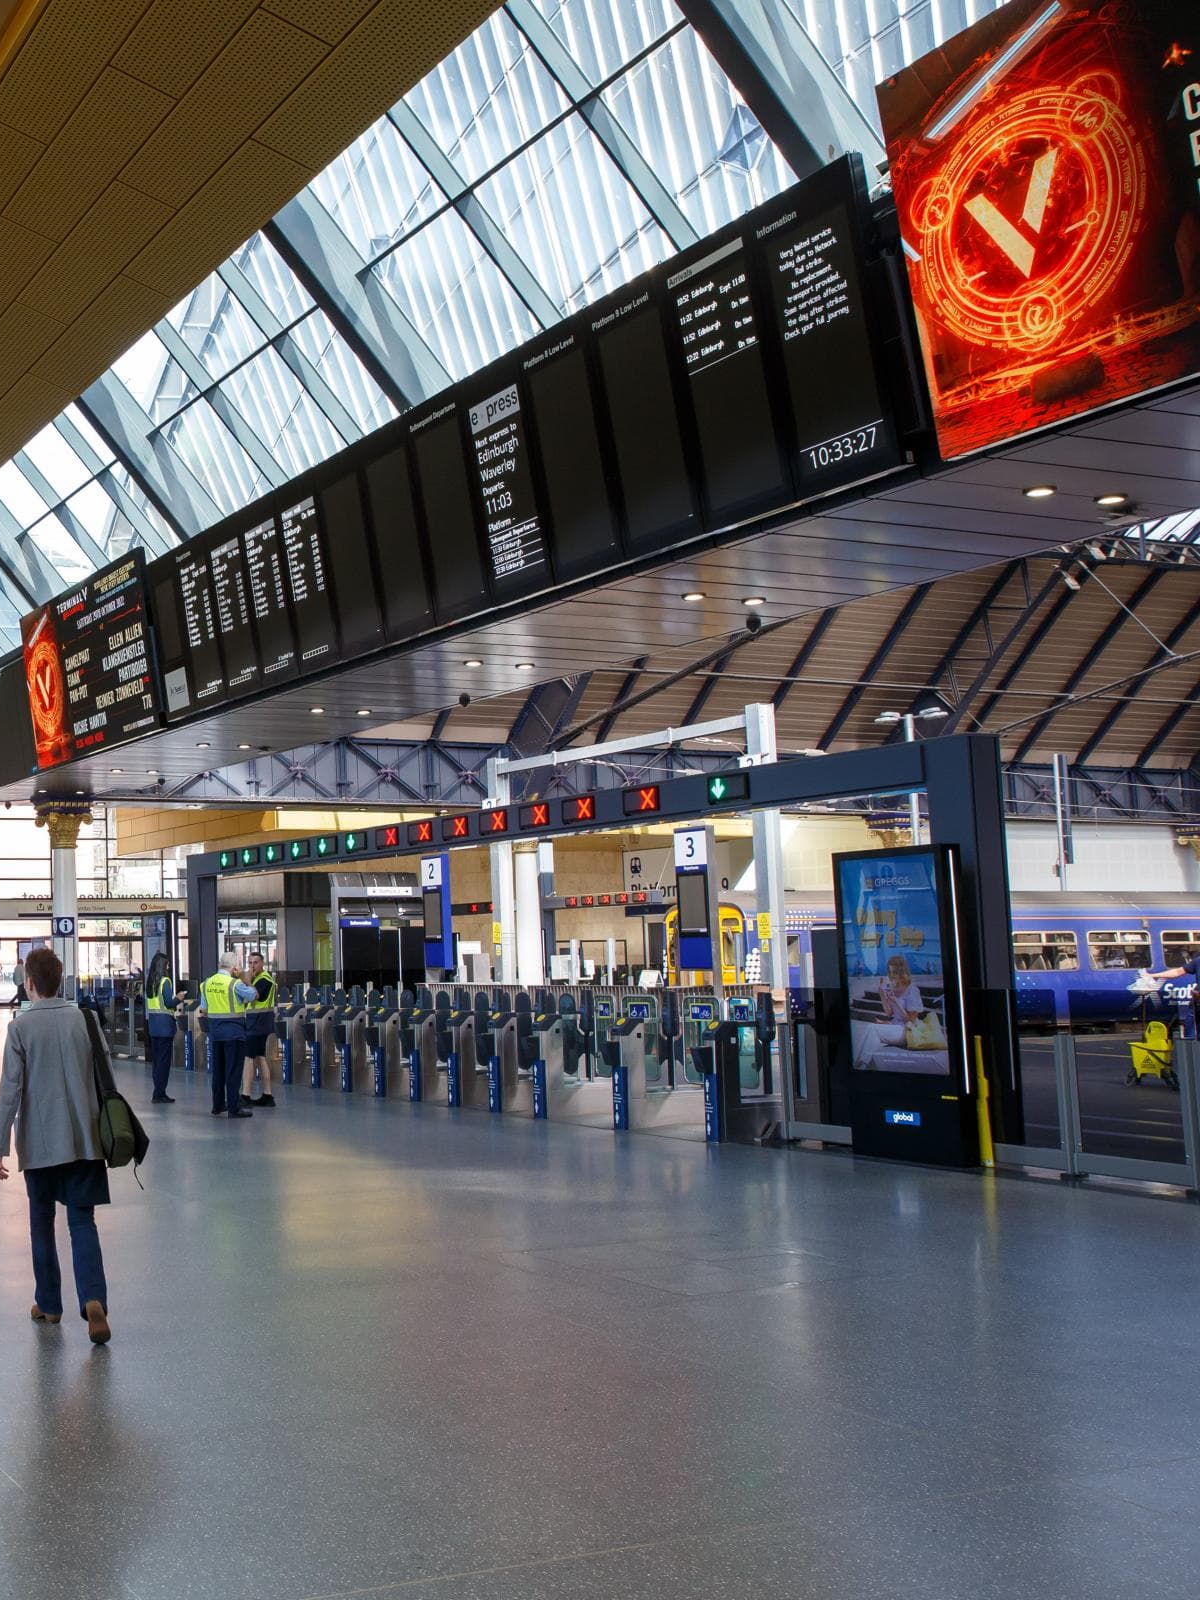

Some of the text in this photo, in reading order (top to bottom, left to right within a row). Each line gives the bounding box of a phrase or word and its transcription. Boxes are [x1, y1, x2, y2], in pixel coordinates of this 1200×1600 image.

[756, 210, 797, 240] Information
[811, 228, 832, 242] service
[779, 260, 795, 272] today
[814, 236, 838, 253] Network
[668, 268, 692, 287] Arrivals
[691, 281, 715, 299] Edinburgh
[787, 285, 814, 303] transport
[798, 295, 821, 310] services
[823, 280, 847, 298] affected
[592, 292, 649, 331] Platform 9 Low Level
[694, 300, 718, 318] Edinburgh
[810, 305, 824, 316] after
[698, 320, 721, 337] Edinburgh
[801, 322, 815, 335] your
[826, 306, 850, 322] journey
[523, 353, 544, 370] Platform
[549, 344, 560, 356] Low
[560, 336, 574, 351] Level
[701, 339, 725, 357] Edinburgh
[432, 402, 456, 419] Departures
[489, 427, 509, 442] express
[478, 435, 519, 464] Edinburgh
[810, 426, 876, 469] 10:33:27
[480, 458, 515, 481] Waverley
[486, 492, 512, 514] 11:03
[488, 518, 512, 533] Platform
[503, 539, 522, 551] Edinburgh
[504, 549, 524, 561] Edinburgh
[505, 559, 525, 571] Edinburgh
[56, 593, 83, 615] TERMINAL
[109, 622, 143, 650] ELLEN ALLIEN
[685, 837, 695, 857] 3
[429, 863, 434, 879] 2
[874, 876, 910, 887] GREGGS
[893, 1113, 914, 1122] global
